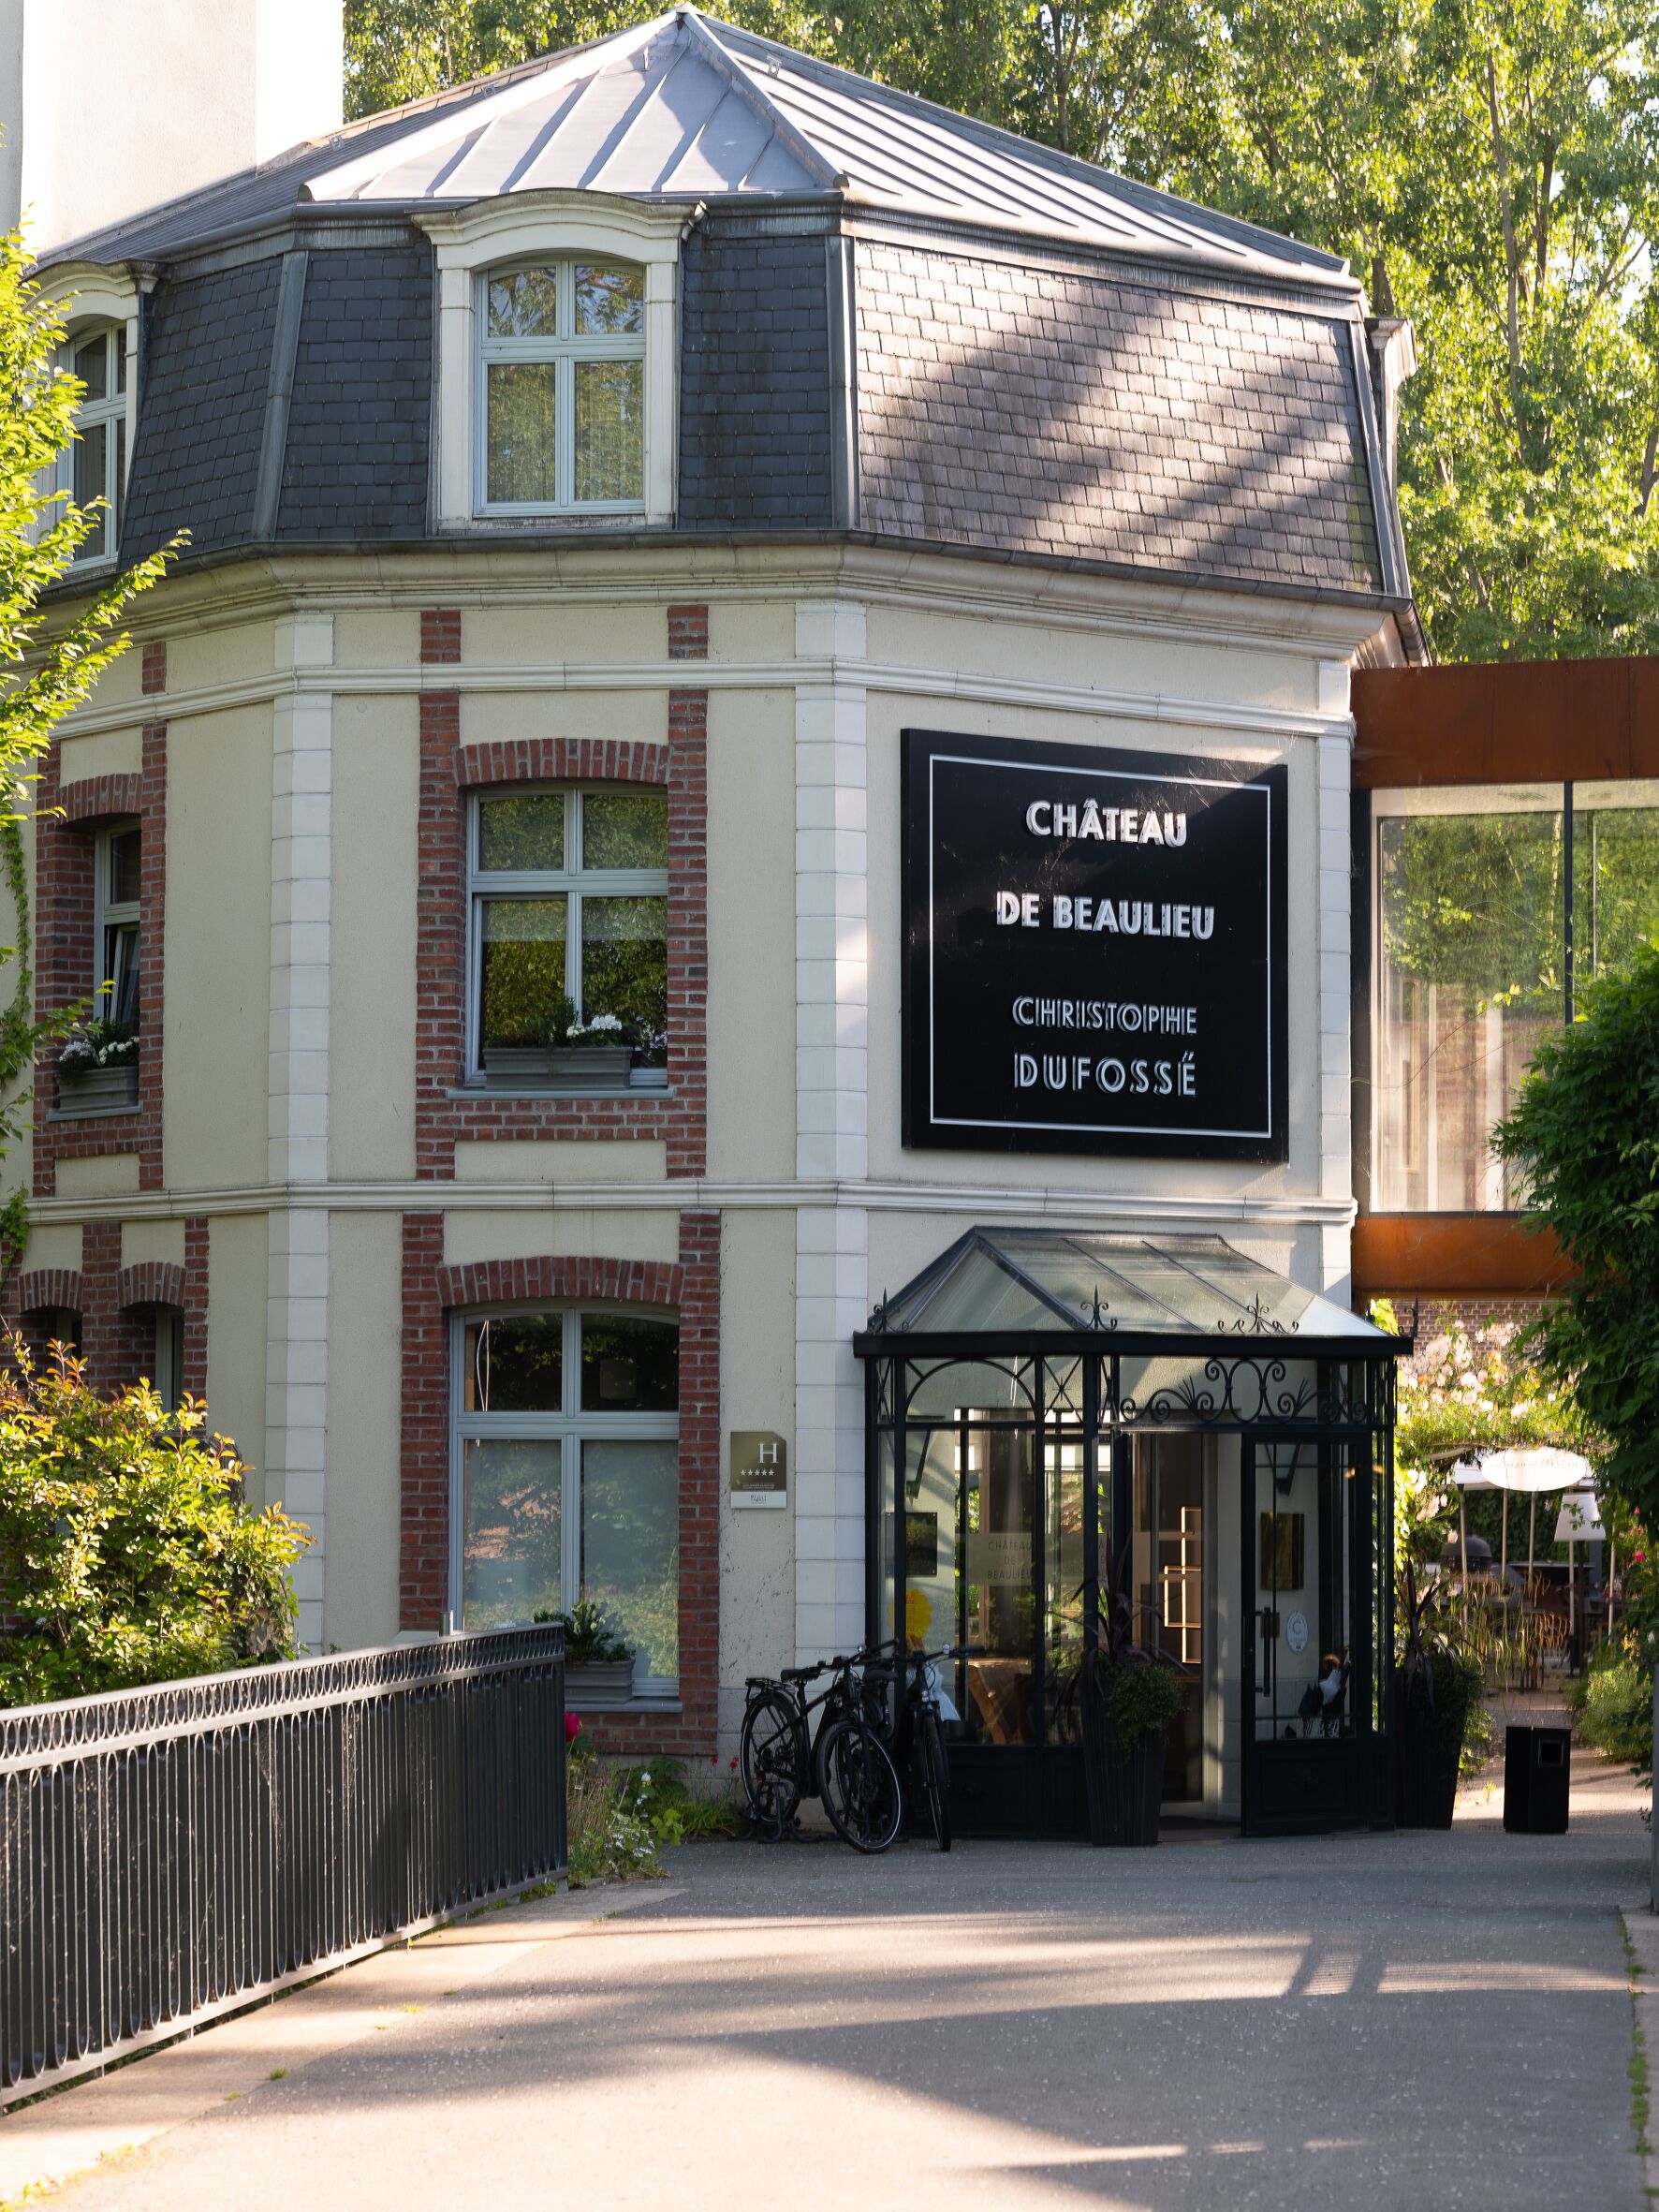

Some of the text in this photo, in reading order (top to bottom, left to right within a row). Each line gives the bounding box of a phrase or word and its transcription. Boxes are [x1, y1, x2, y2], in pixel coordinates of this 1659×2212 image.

[1025, 798, 1187, 848] CHÂTEAU
[996, 891, 1214, 940] DE BEAULIEU
[1012, 995, 1197, 1035] CHRISTOPHE
[1014, 1051, 1196, 1097] DUFOSSÉ
[757, 1442, 779, 1464] H
